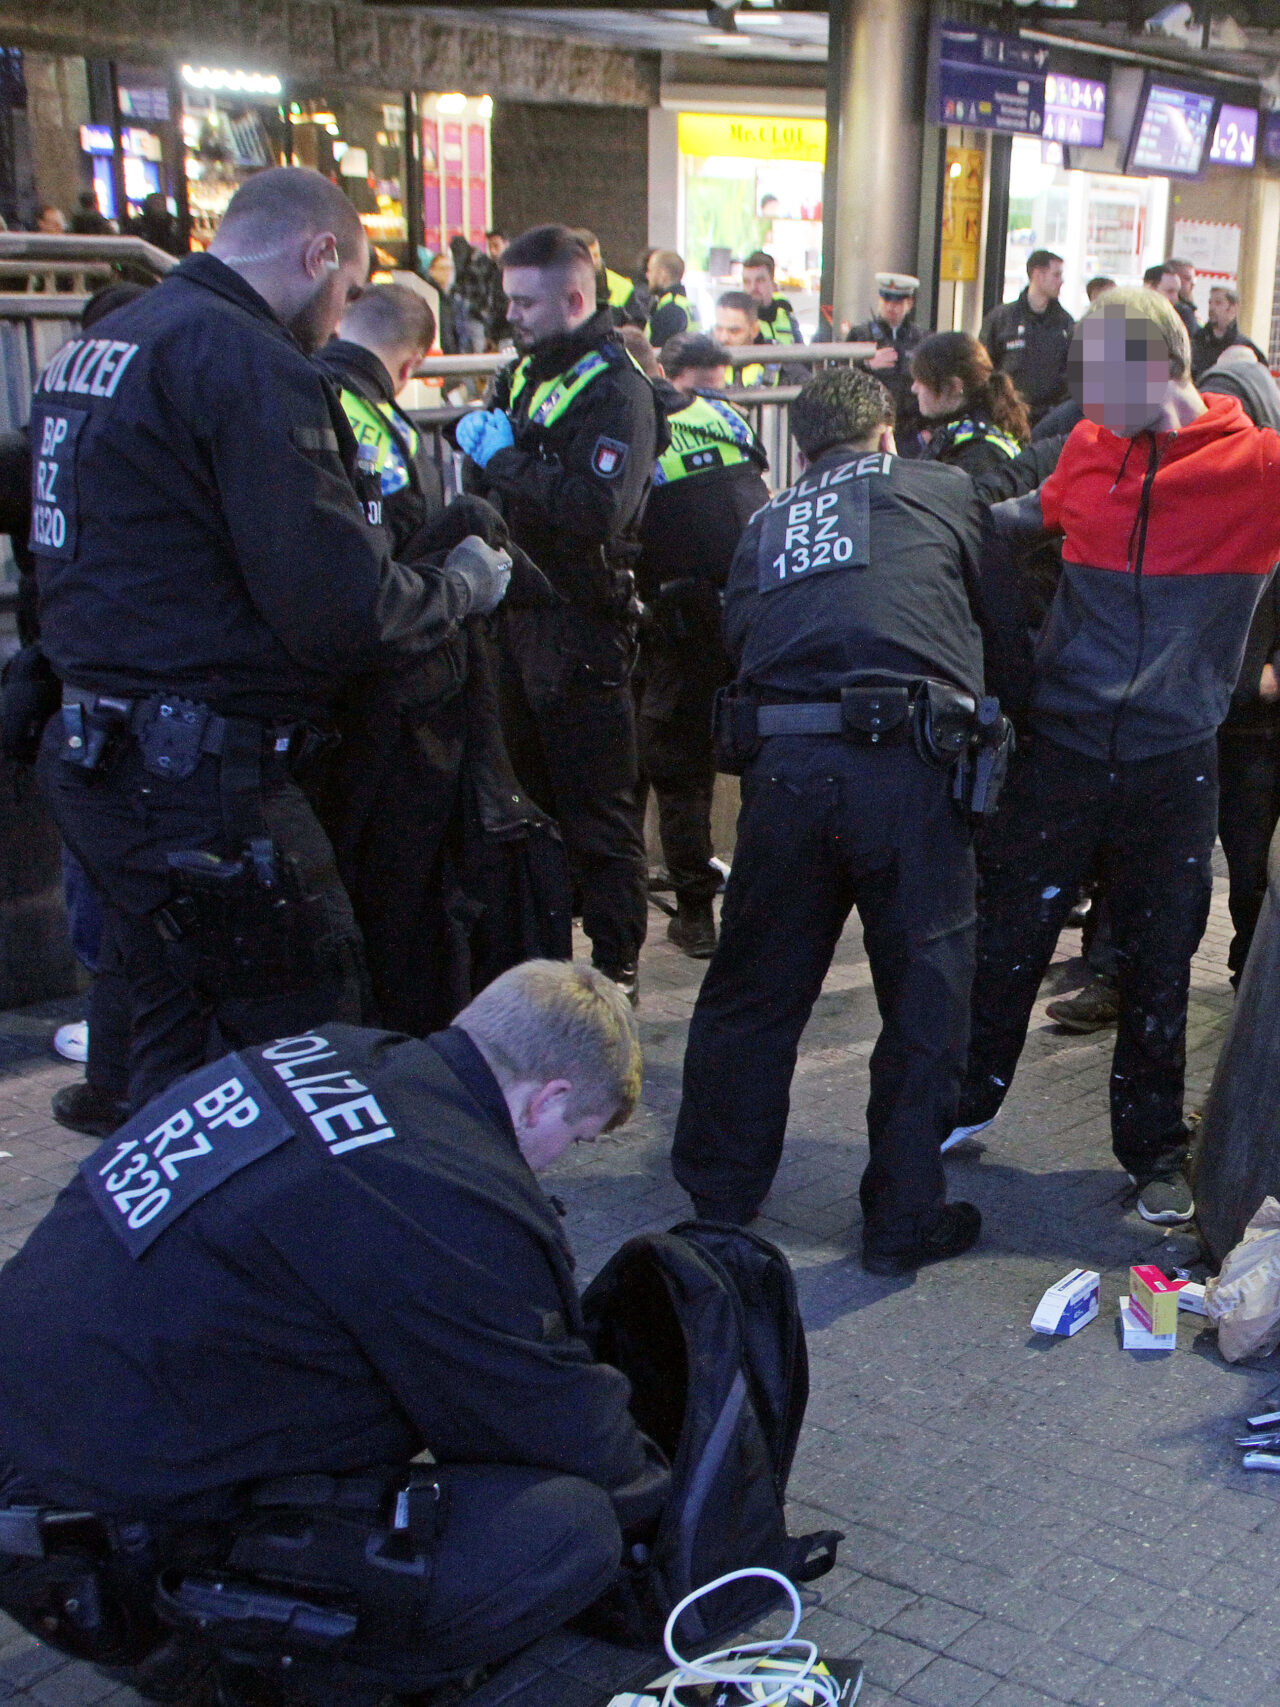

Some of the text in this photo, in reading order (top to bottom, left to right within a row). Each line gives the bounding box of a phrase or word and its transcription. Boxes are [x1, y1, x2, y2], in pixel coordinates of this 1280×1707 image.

[40, 416, 68, 457] BP
[36, 460, 60, 503] RZ
[788, 492, 839, 526] BP
[785, 514, 839, 550] RZ
[772, 536, 854, 580] 1320
[192, 1076, 261, 1130] BP
[144, 1108, 214, 1182] RZ
[98, 1139, 172, 1230] 1320
